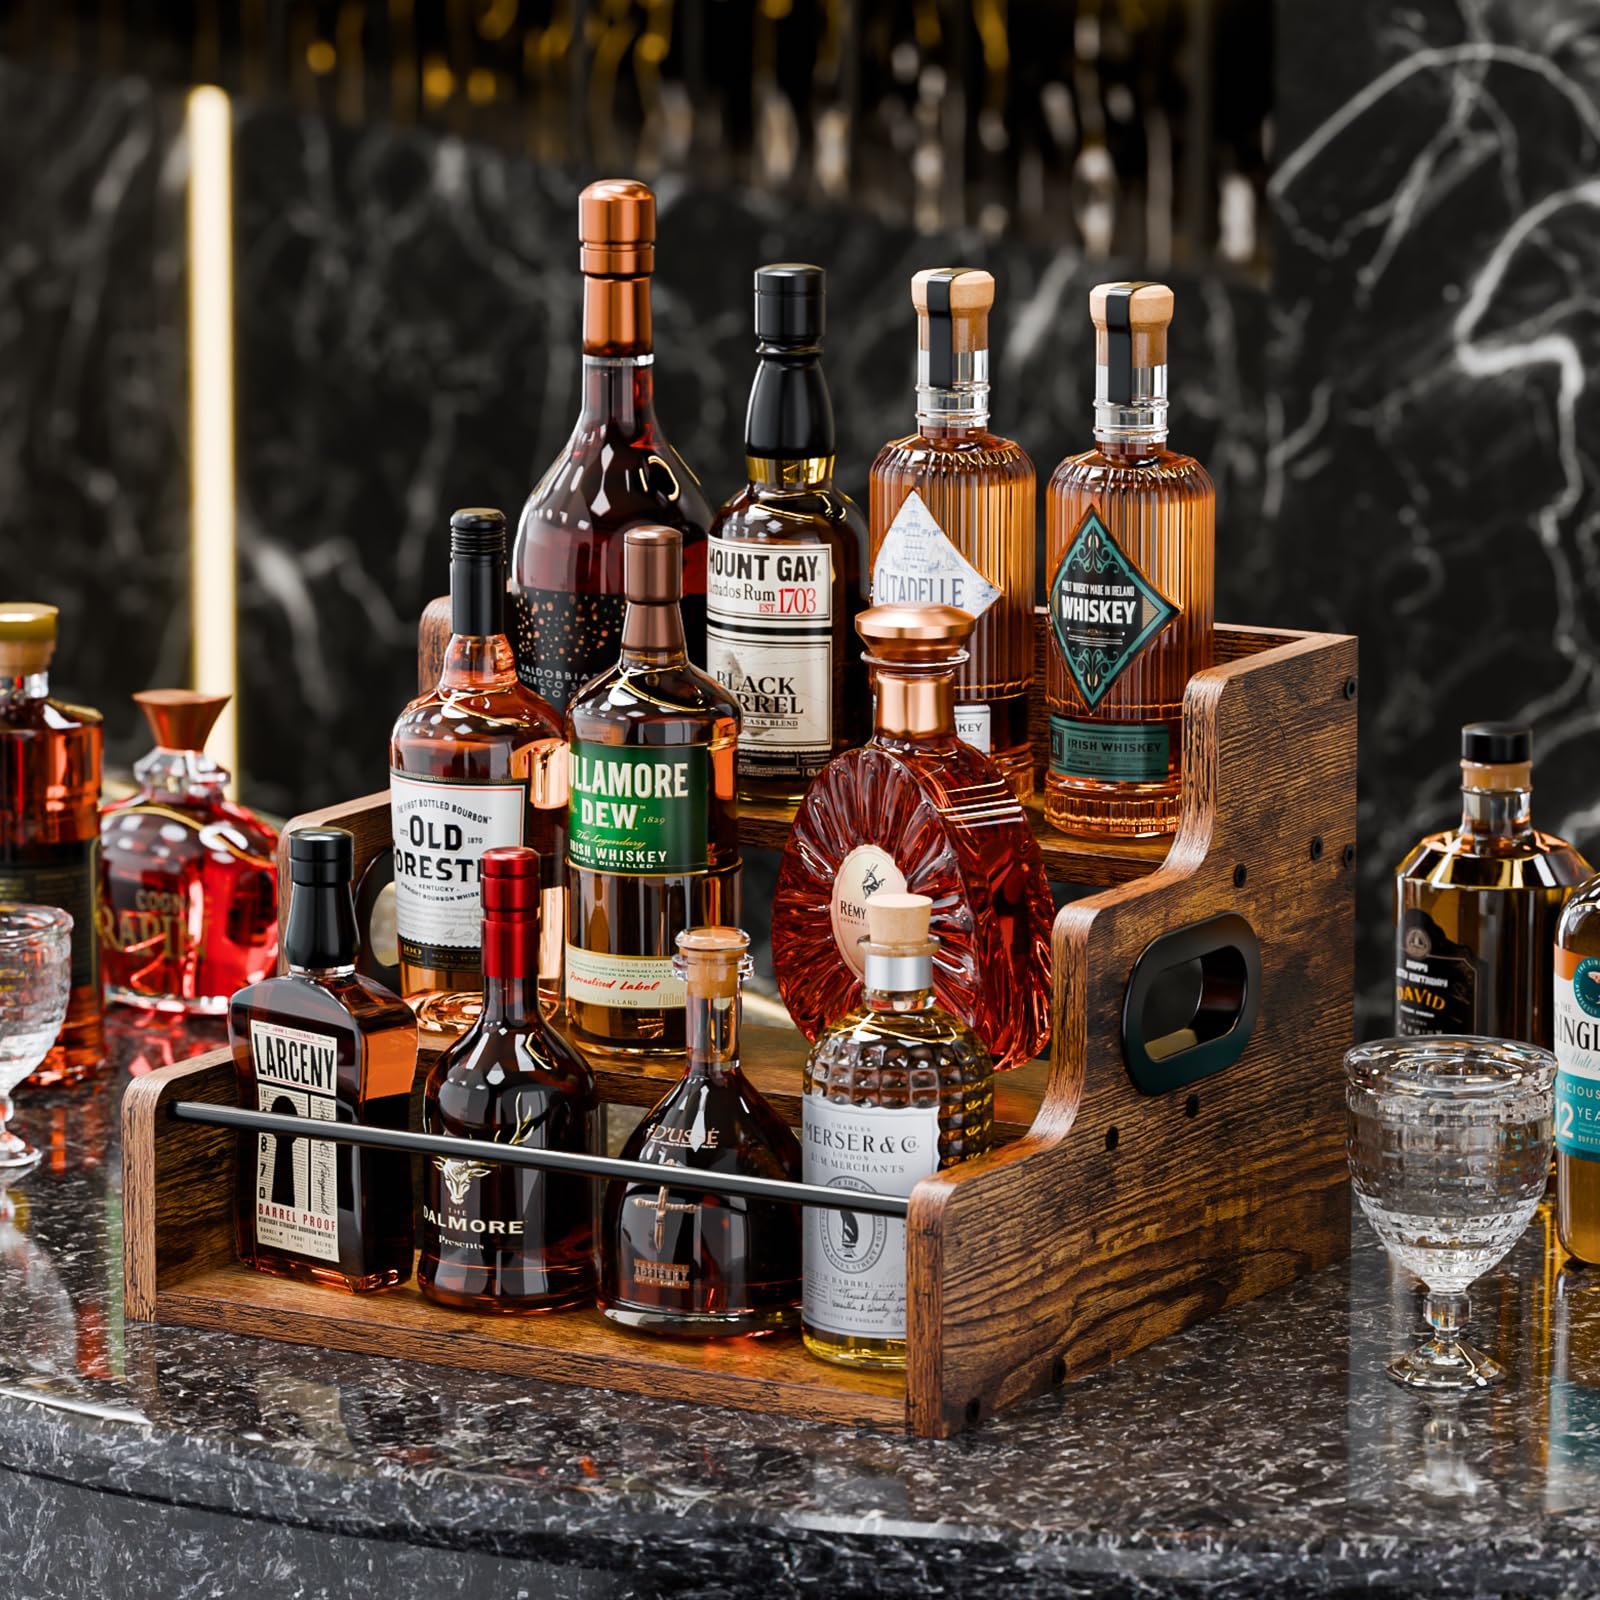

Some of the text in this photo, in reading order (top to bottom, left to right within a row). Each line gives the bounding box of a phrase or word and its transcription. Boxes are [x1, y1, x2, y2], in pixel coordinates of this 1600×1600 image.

[777, 555, 818, 583] GAY
[744, 583, 775, 602] Rum
[778, 588, 816, 614] 1703
[1061, 595, 1137, 625] WHISKEY
[716, 670, 796, 695] BLACK
[737, 692, 804, 715] RREL
[769, 718, 799, 727] BLEND
[1068, 738, 1098, 751] IRISH
[1102, 742, 1162, 753] WHISKEY
[568, 752, 689, 799] ULLAMORE
[419, 798, 450, 811] BOTTLED
[409, 814, 462, 851] OLD
[590, 834, 647, 850] Legendary
[569, 838, 667, 863] IRISH WHISKEY
[395, 848, 482, 883] OREST
[598, 861, 654, 869] DISTILLED
[456, 891, 480, 901] WHISK
[840, 900, 867, 920] RÉMY
[619, 981, 660, 992] Label
[1396, 985, 1446, 1010] DAVID
[254, 1032, 335, 1091] LARCENY
[1577, 1105, 1600, 1121] YEA
[650, 1124, 720, 1146] D'USÉ
[880, 1135, 896, 1154] &
[830, 1159, 905, 1174] MERCHANTS
[258, 1202, 336, 1232] BARREL PROOF
[423, 1205, 525, 1235] DALMORE
[438, 1234, 485, 1250] Presents
